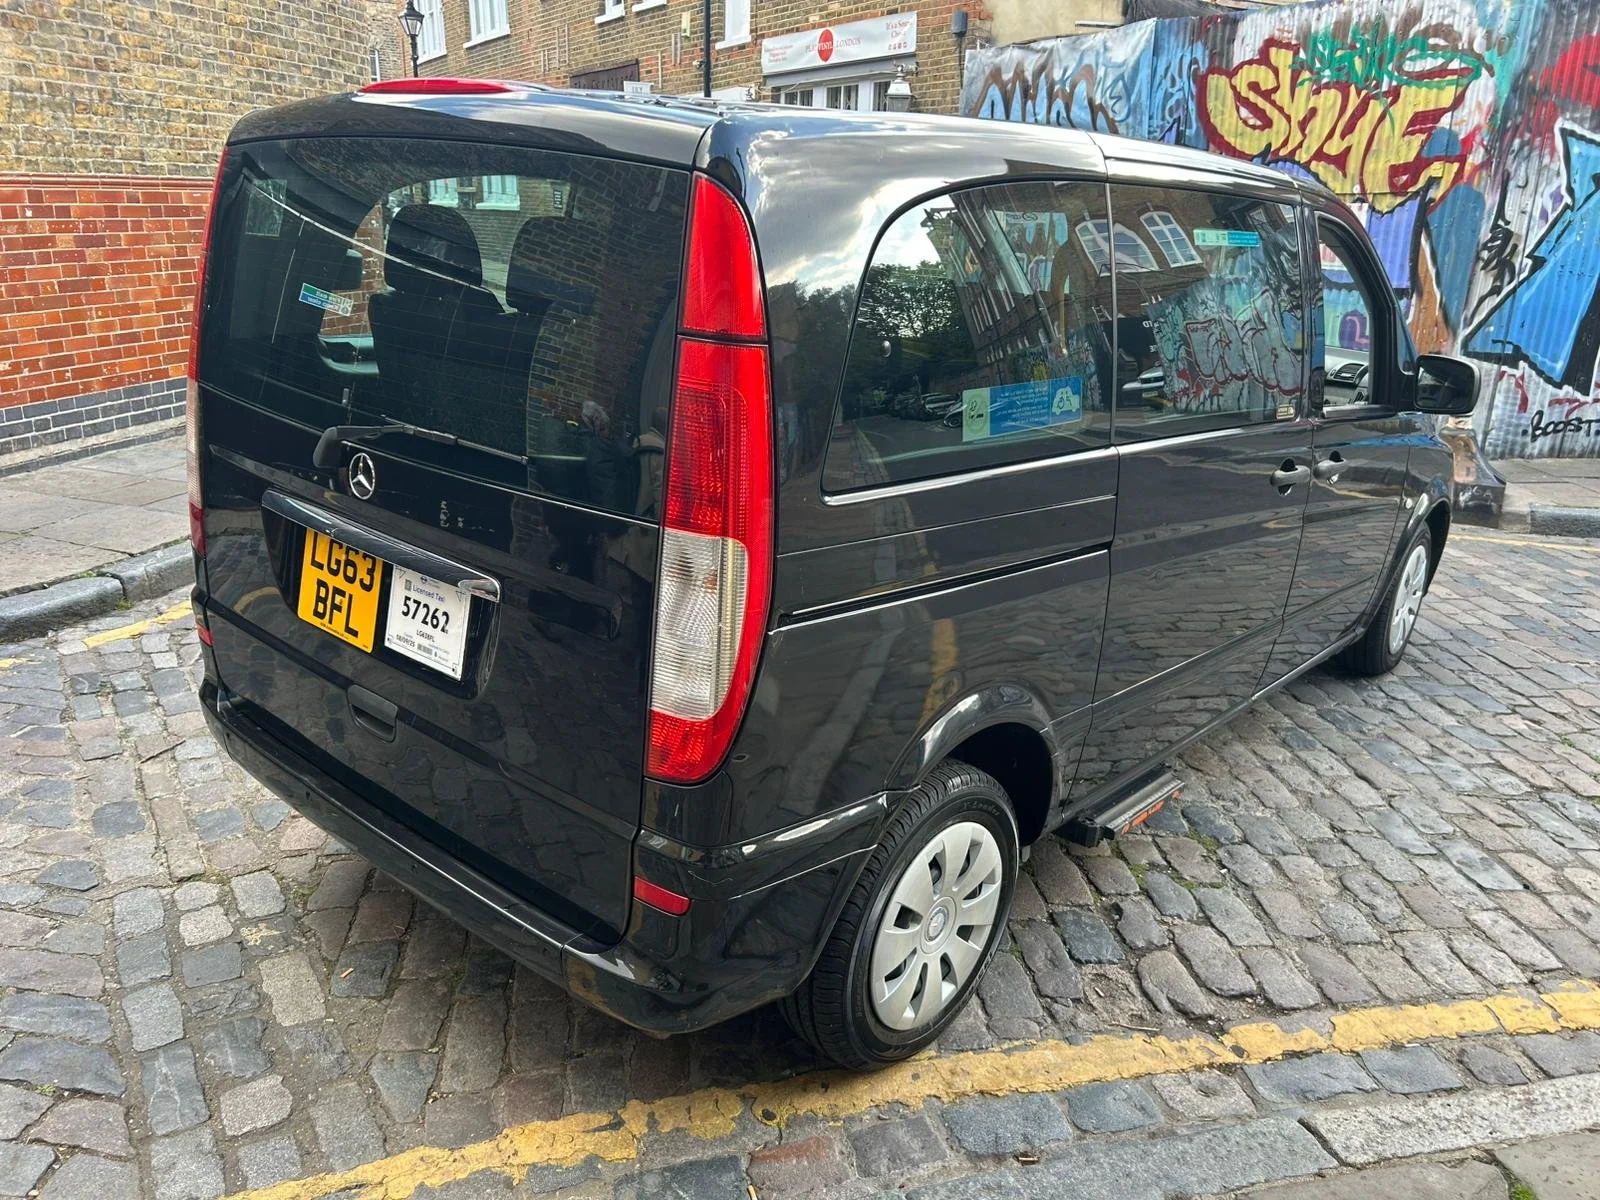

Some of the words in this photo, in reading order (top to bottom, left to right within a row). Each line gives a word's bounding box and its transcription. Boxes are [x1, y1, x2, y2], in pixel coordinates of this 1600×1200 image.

[311, 531, 377, 593] LG63
[313, 578, 358, 639] BFL
[402, 595, 450, 635] 57262
